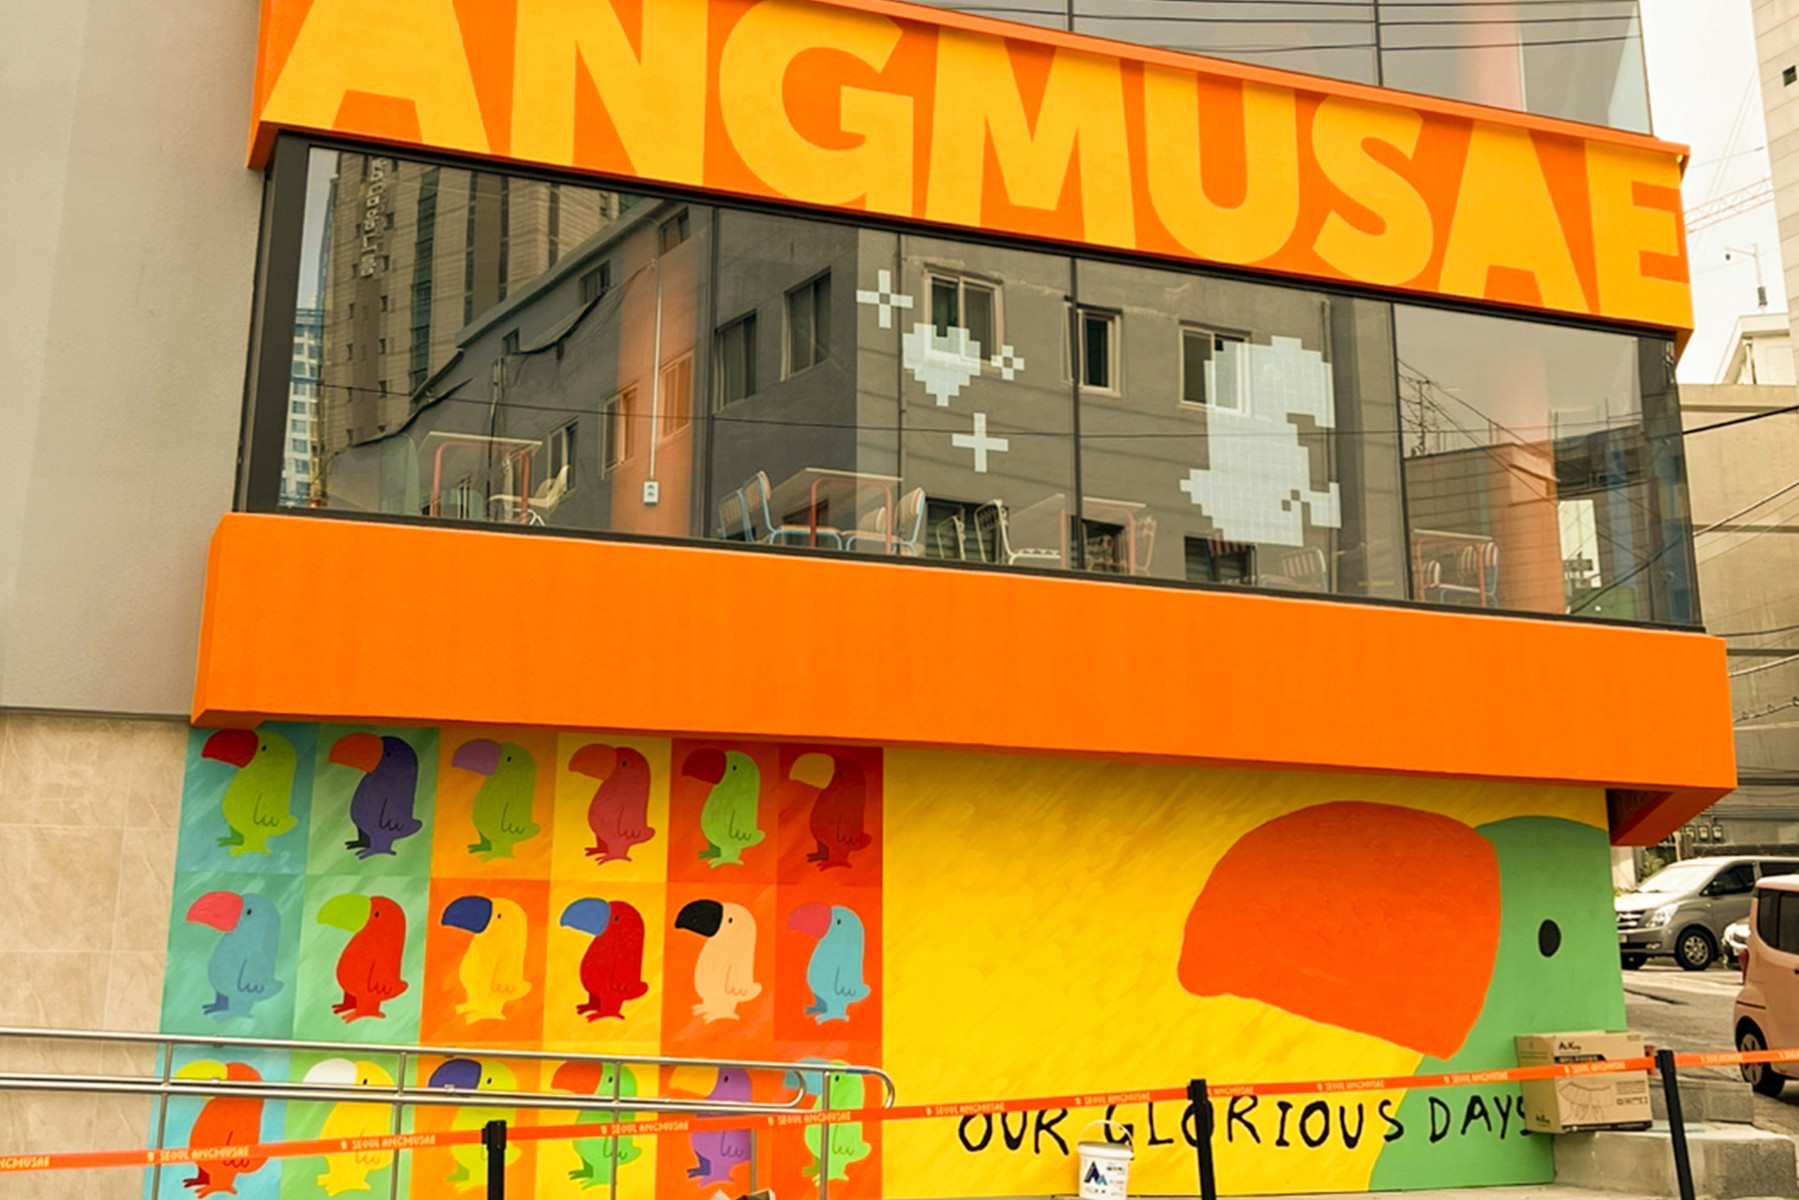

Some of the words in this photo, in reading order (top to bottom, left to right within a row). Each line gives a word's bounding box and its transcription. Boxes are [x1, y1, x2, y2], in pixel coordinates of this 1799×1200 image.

[260, 0, 1694, 330] ANGMUSAE
[958, 1108, 1069, 1156] OUR
[1104, 1095, 1405, 1153] GLORIOUS
